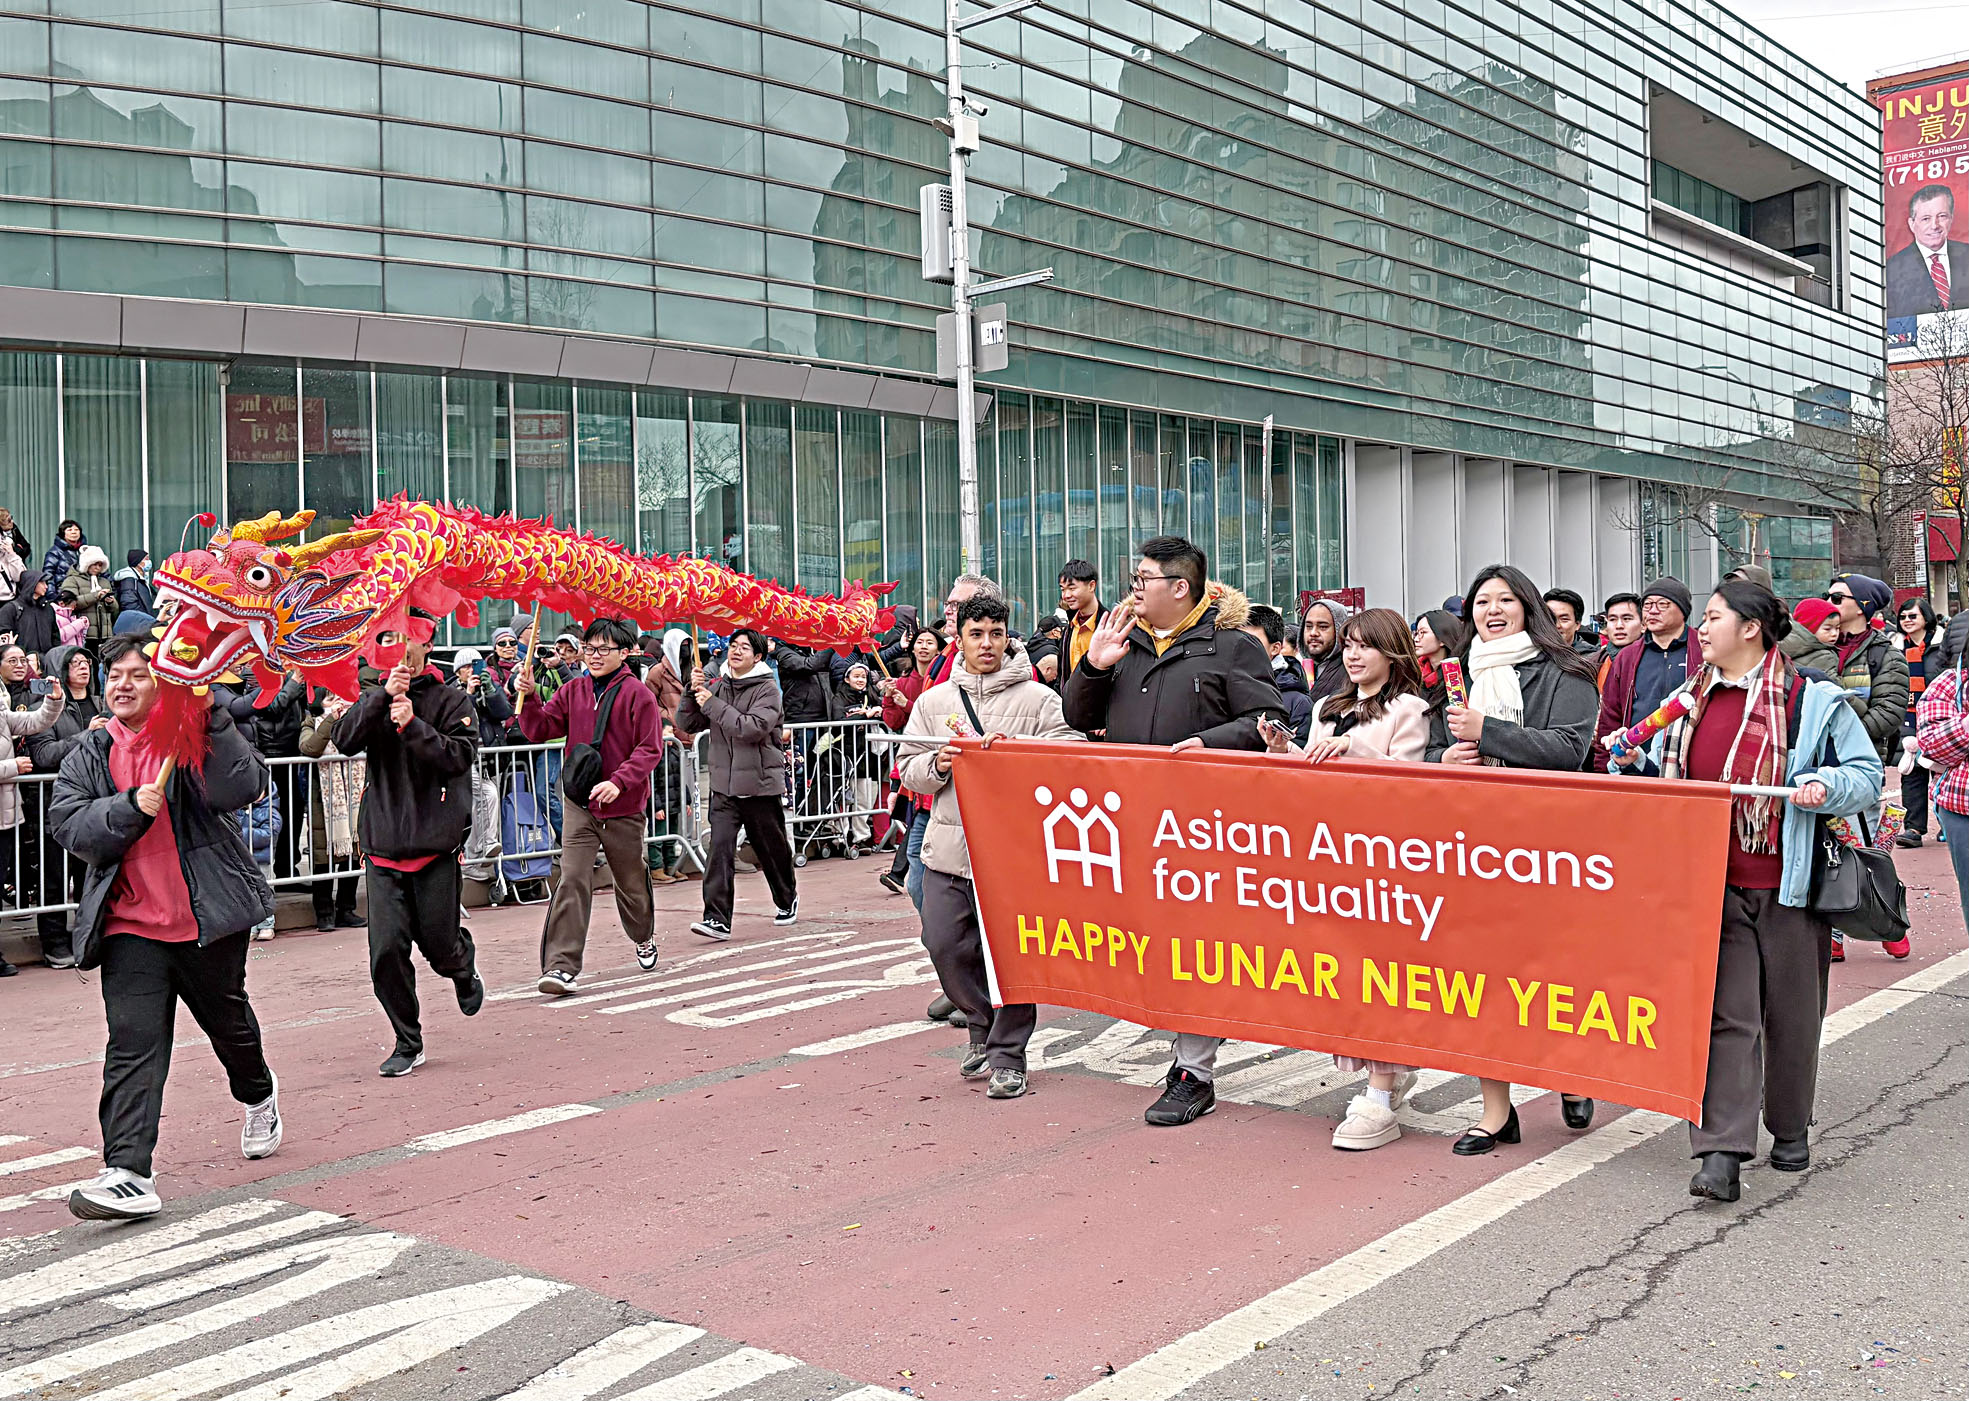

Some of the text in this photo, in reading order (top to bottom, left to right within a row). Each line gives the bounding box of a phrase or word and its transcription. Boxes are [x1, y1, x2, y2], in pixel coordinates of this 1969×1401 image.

[1886, 85, 1969, 127] INJU
[1888, 155, 1969, 187] (718) 5
[1928, 143, 1968, 156] Hablamos
[1153, 809, 1614, 891] Asian Americans
[1153, 857, 1445, 942] for Equality
[1018, 914, 1657, 1050] HAPPY LUNAR NEW YEAR
